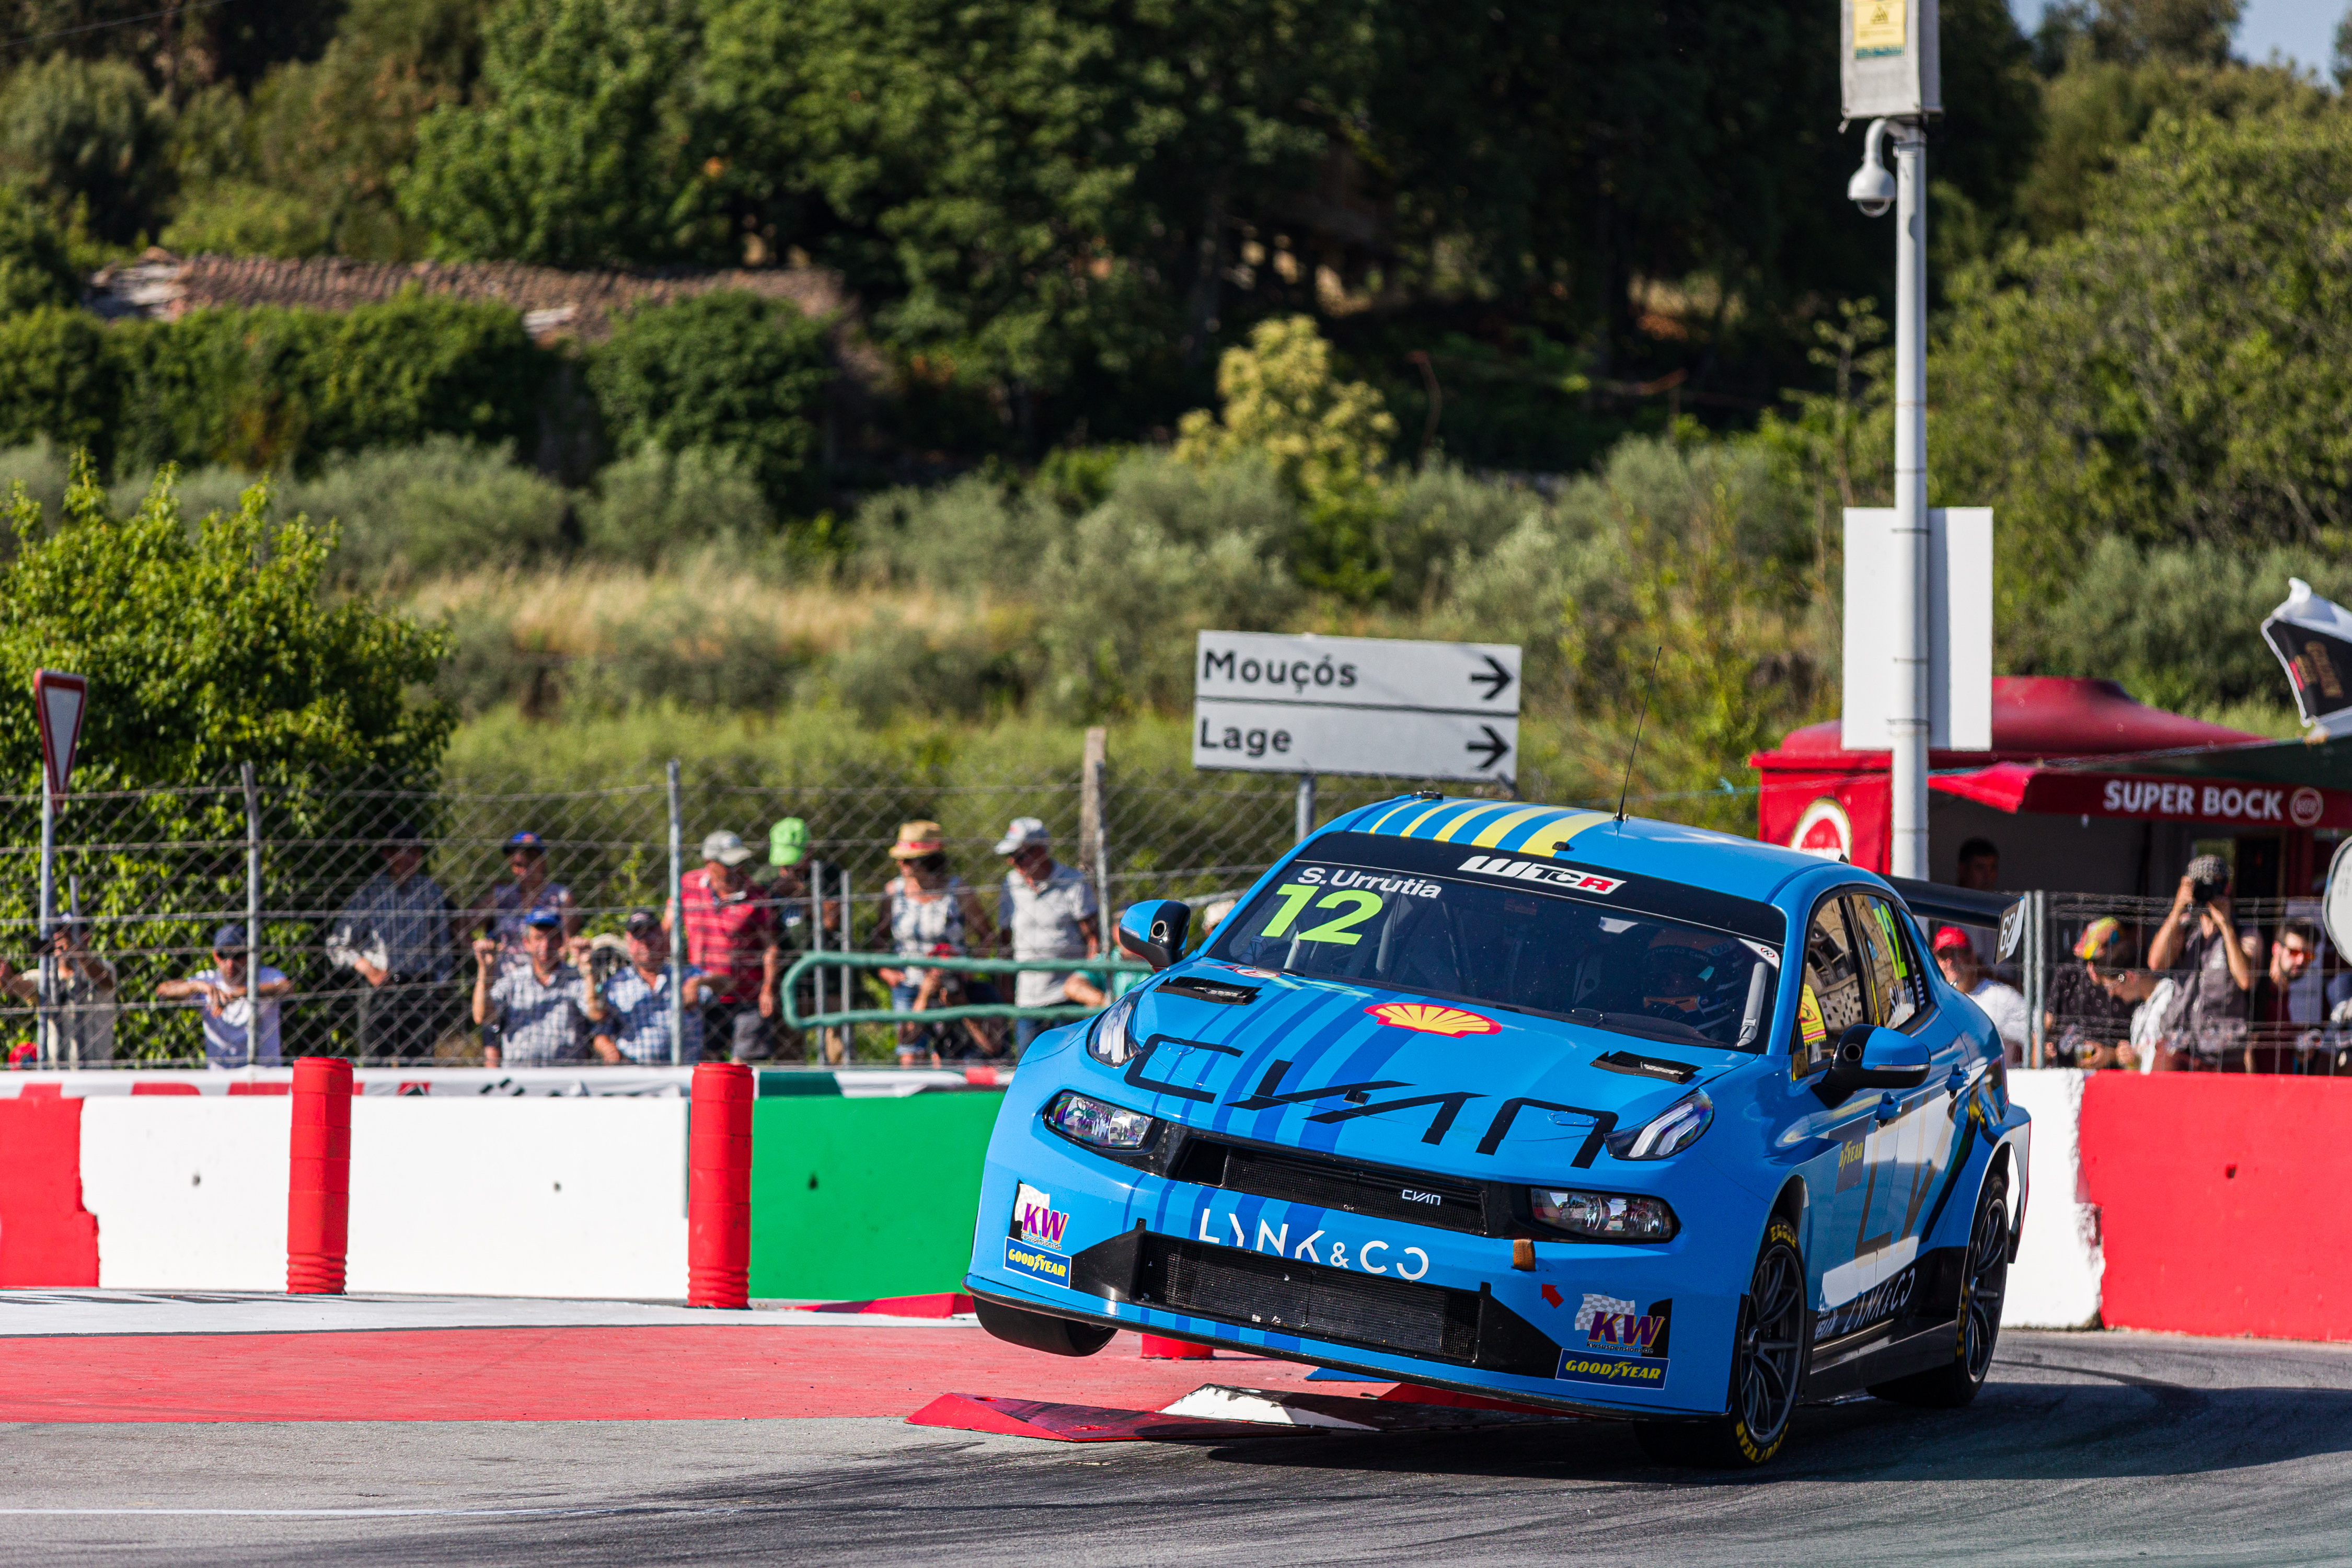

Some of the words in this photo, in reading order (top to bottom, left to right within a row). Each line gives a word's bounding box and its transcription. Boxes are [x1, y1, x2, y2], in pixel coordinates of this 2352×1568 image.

[1202, 649, 1358, 695] Mouçós
[1200, 717, 1292, 757] Lage
[2103, 779, 2195, 815] SUPER
[2201, 786, 2284, 821] BOCK
[1261, 883, 1383, 946] 12
[1873, 904, 1908, 981] 12
[1021, 1202, 1070, 1243] KW
[1021, 1231, 1062, 1251] kwsuspensions.de
[1008, 1248, 1067, 1277] GOODYEAR
[1586, 1341, 1654, 1354] kwsuspensions.de
[1587, 1310, 1665, 1347] KW
[1565, 1360, 1661, 1379] GOODYEAR
